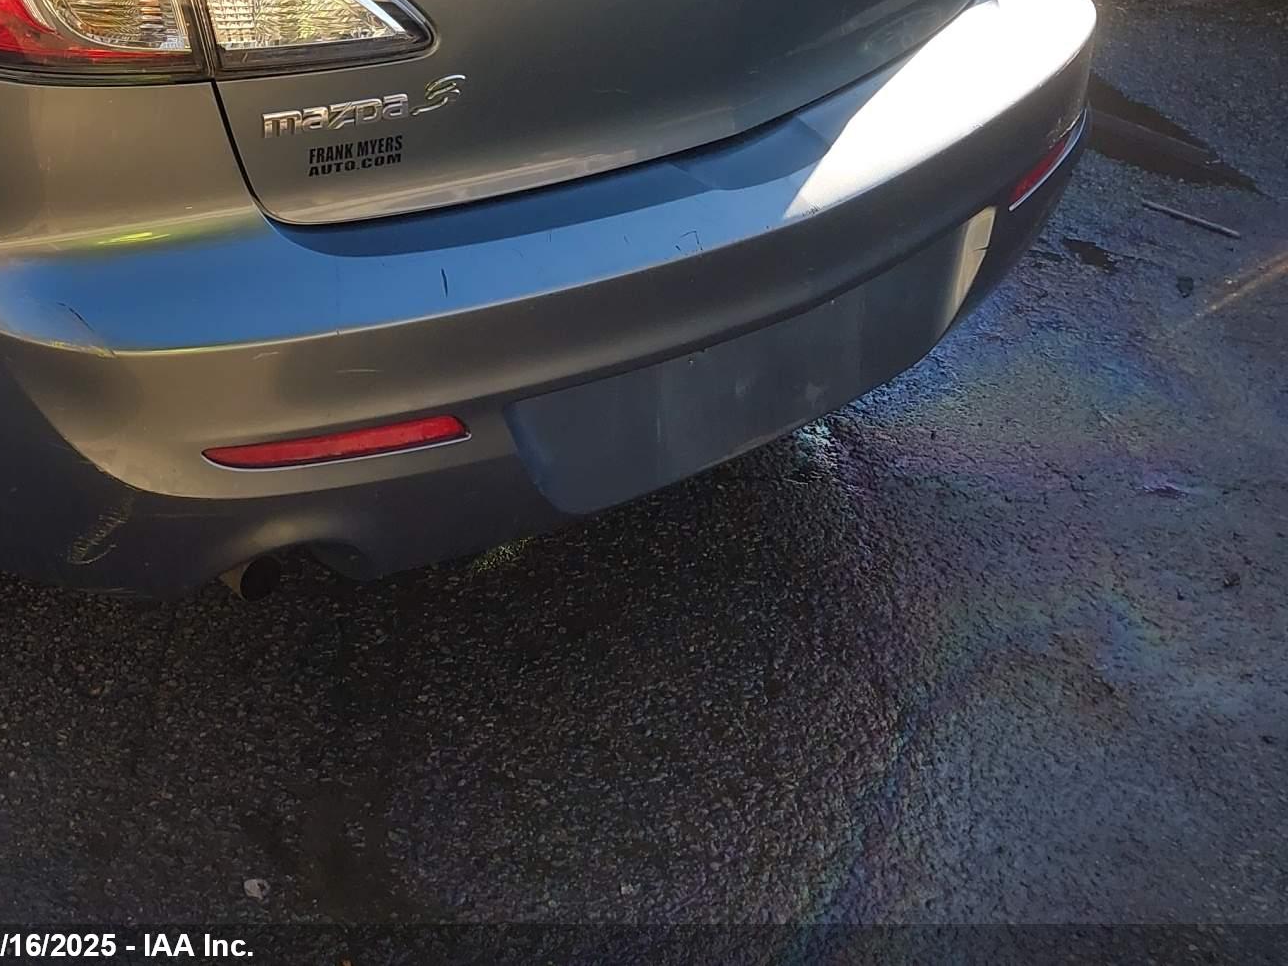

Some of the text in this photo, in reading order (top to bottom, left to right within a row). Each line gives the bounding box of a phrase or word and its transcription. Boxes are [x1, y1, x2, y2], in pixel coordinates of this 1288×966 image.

[308, 135, 404, 165] FRANK MYERS
[308, 153, 402, 177] AUTO.COM
